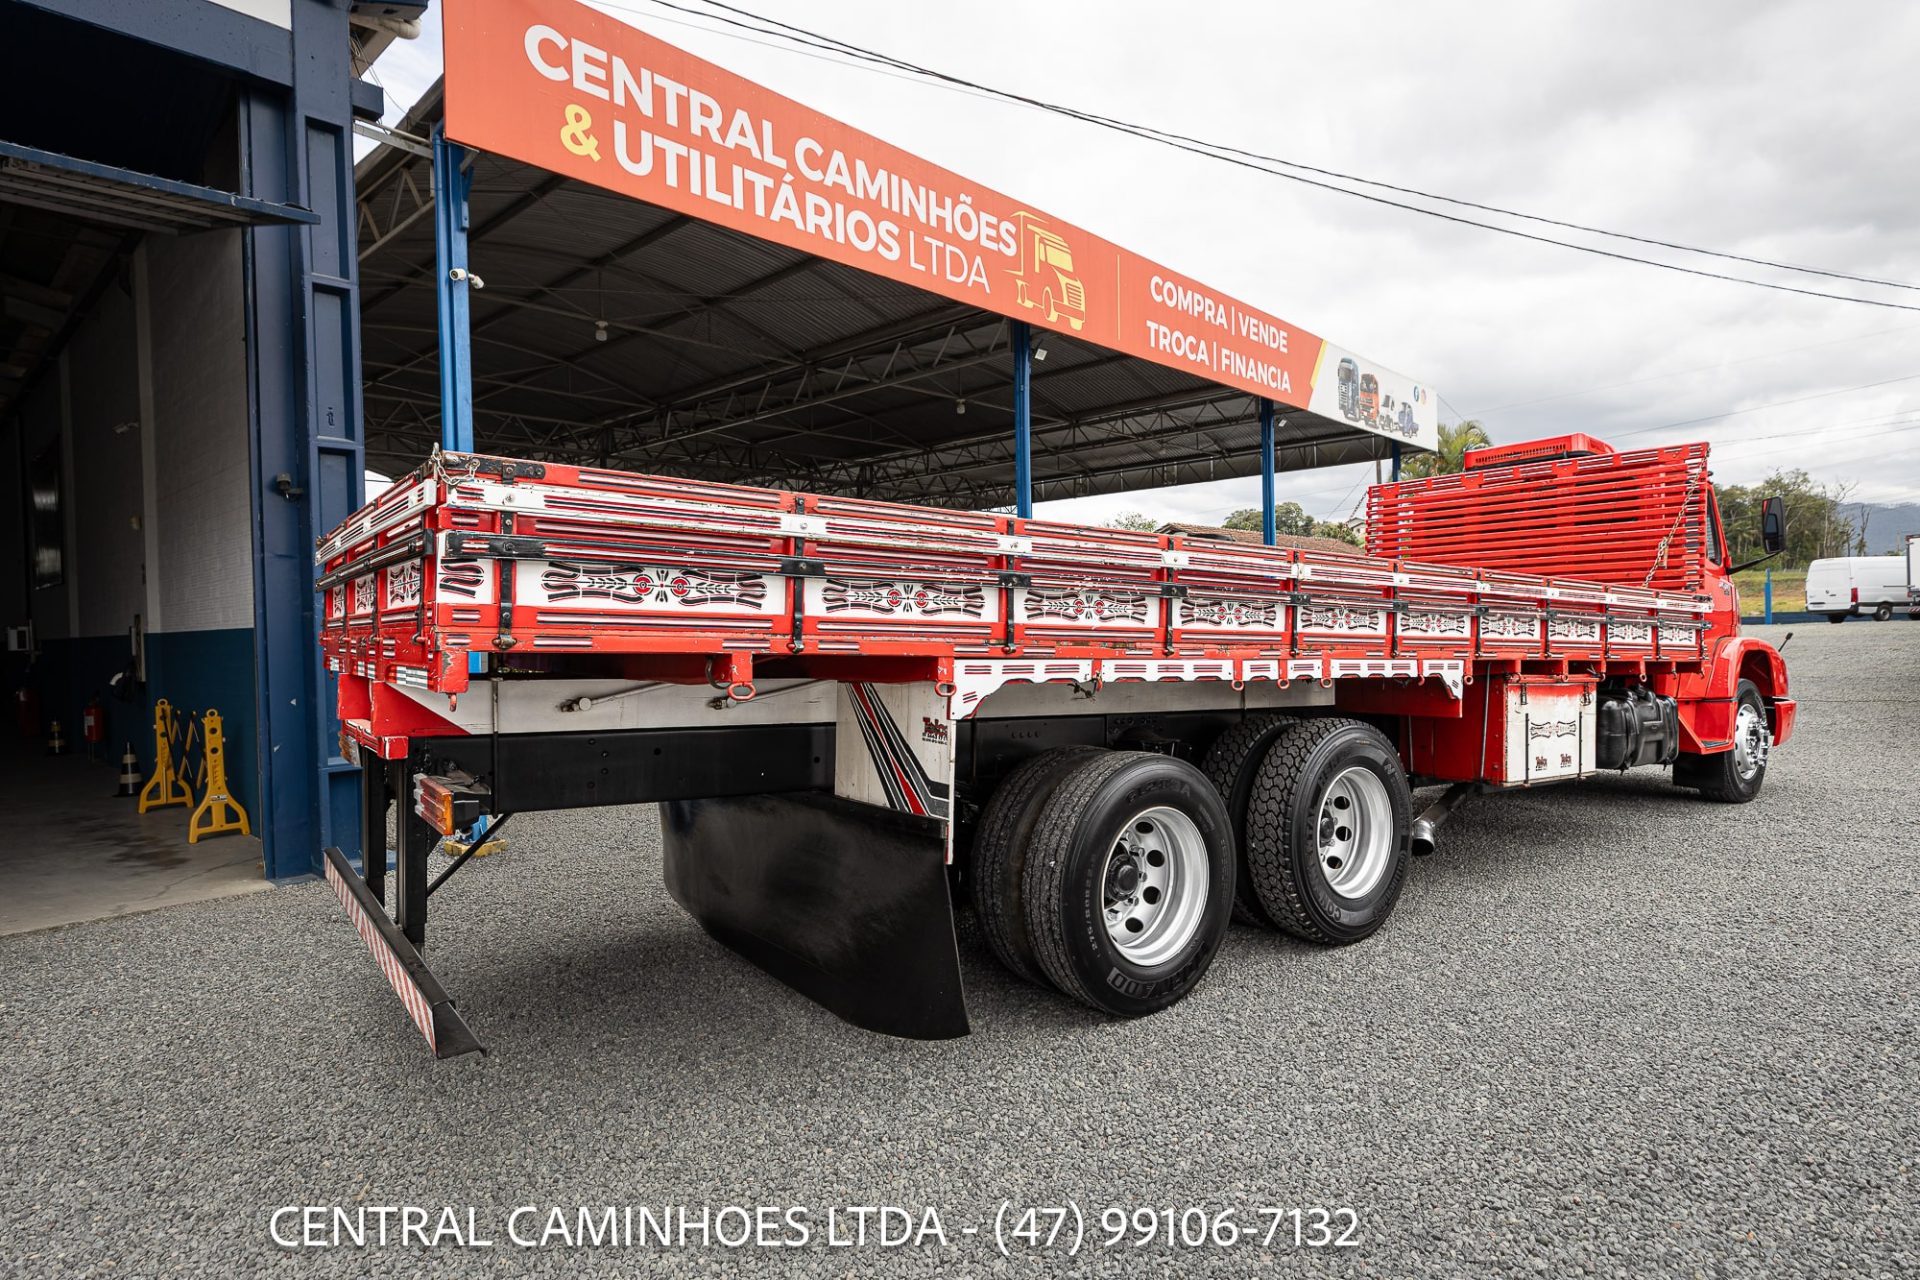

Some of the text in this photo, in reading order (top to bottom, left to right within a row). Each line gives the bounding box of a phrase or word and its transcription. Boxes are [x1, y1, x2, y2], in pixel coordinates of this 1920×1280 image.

[525, 24, 1018, 257] CENTRAL CAMINHÕES
[560, 104, 990, 293] & UTILITÁRIOS LTDA
[1146, 320, 1292, 393] TROCA FINANCIA
[1150, 275, 1288, 353] COMPRA VENDE
